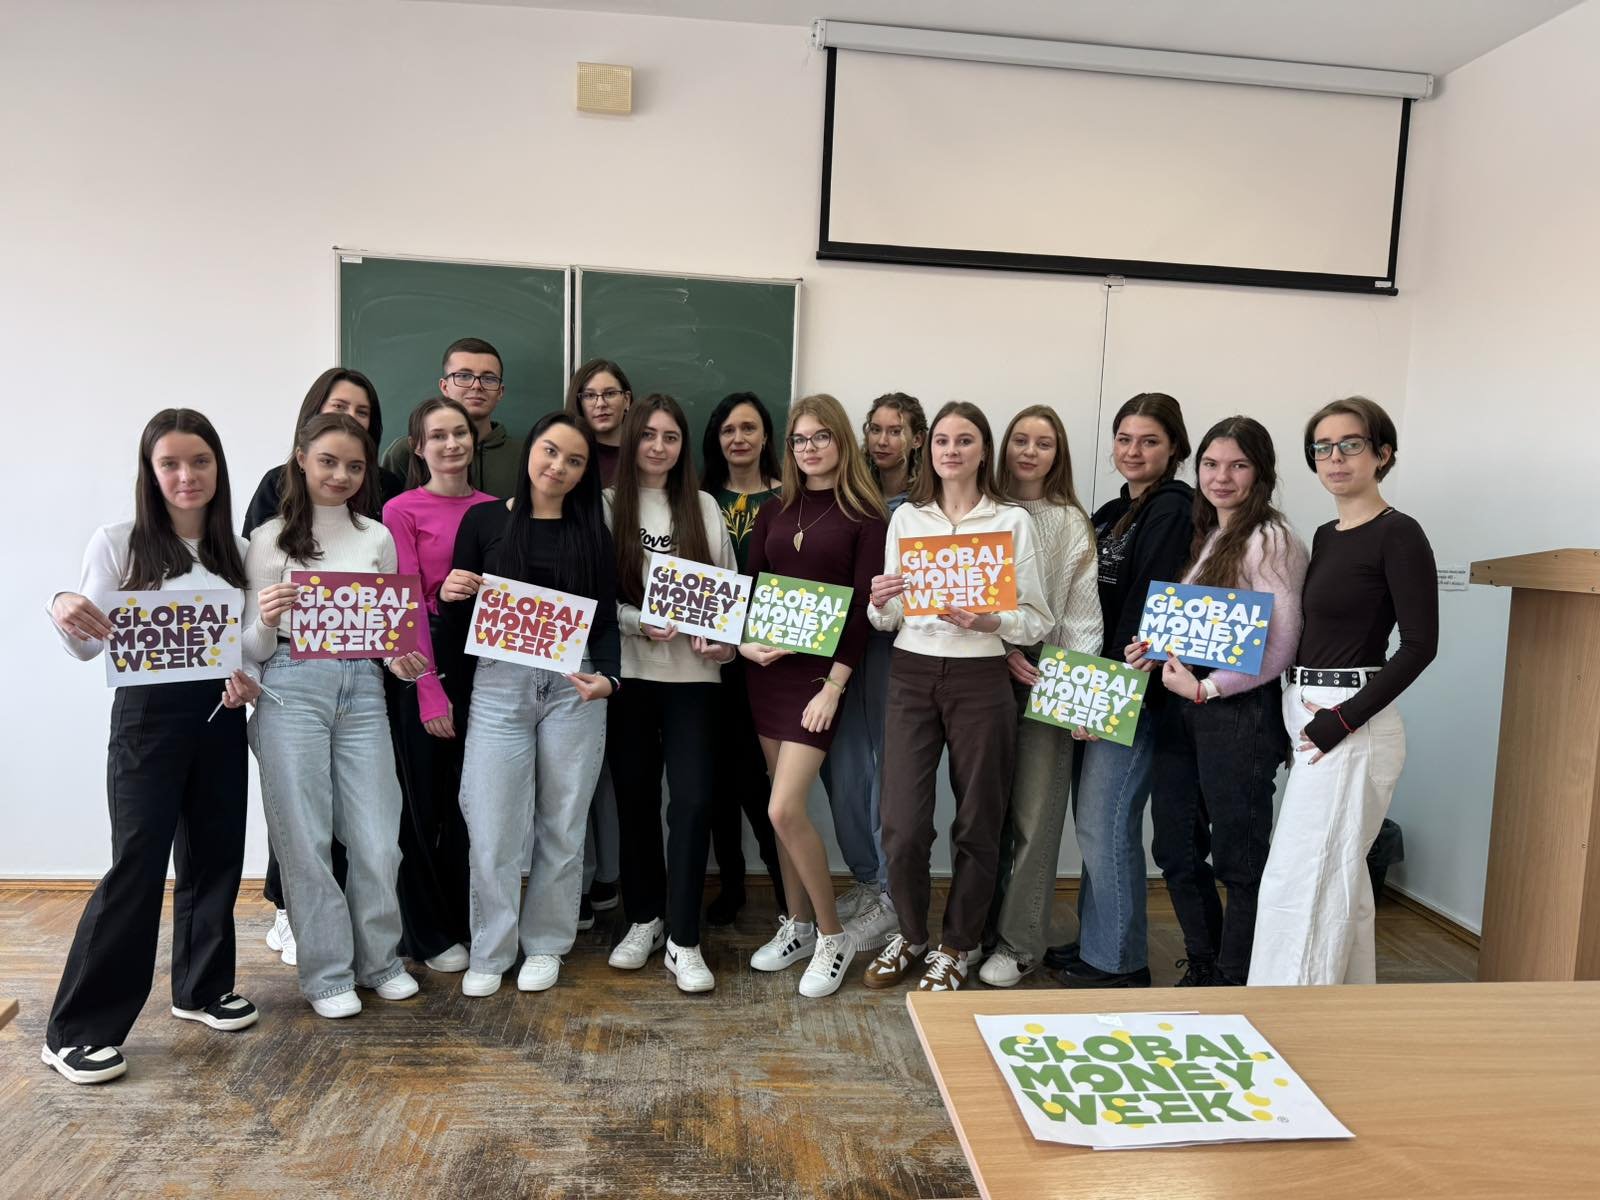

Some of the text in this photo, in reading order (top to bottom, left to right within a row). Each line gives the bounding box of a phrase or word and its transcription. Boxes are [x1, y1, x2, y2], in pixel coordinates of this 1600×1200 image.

[901, 545, 1013, 570] GLOBAL
[652, 566, 746, 602] GLOBAL
[902, 565, 1003, 589] MONEY
[297, 585, 419, 609] GLOBAL
[481, 588, 588, 629] GLOBAL
[647, 597, 718, 630] WEEK
[649, 582, 737, 615] MONEY
[755, 584, 847, 618] GLOBAL
[903, 586, 987, 610] WEEK
[1146, 593, 1268, 627] GLOBAL
[108, 604, 239, 629] GLOBAL
[292, 607, 407, 630] MONEY
[476, 607, 578, 642] MONEY
[749, 602, 837, 632] MONEY
[1141, 612, 1255, 645] MONEY
[109, 625, 227, 651] MONEY
[291, 629, 387, 652] WEEK
[474, 624, 556, 659] WEEK
[748, 619, 817, 649] WEEK
[1139, 630, 1231, 663] WEEK
[109, 646, 208, 673] WEEK
[1032, 676, 1131, 715] MONEY
[1038, 657, 1143, 701] GLOBAL
[1031, 693, 1108, 732] WEEK
[999, 1034, 1274, 1063] GLOBAL
[1010, 1061, 1257, 1094] MONEY
[1020, 1089, 1257, 1126] WEEK
